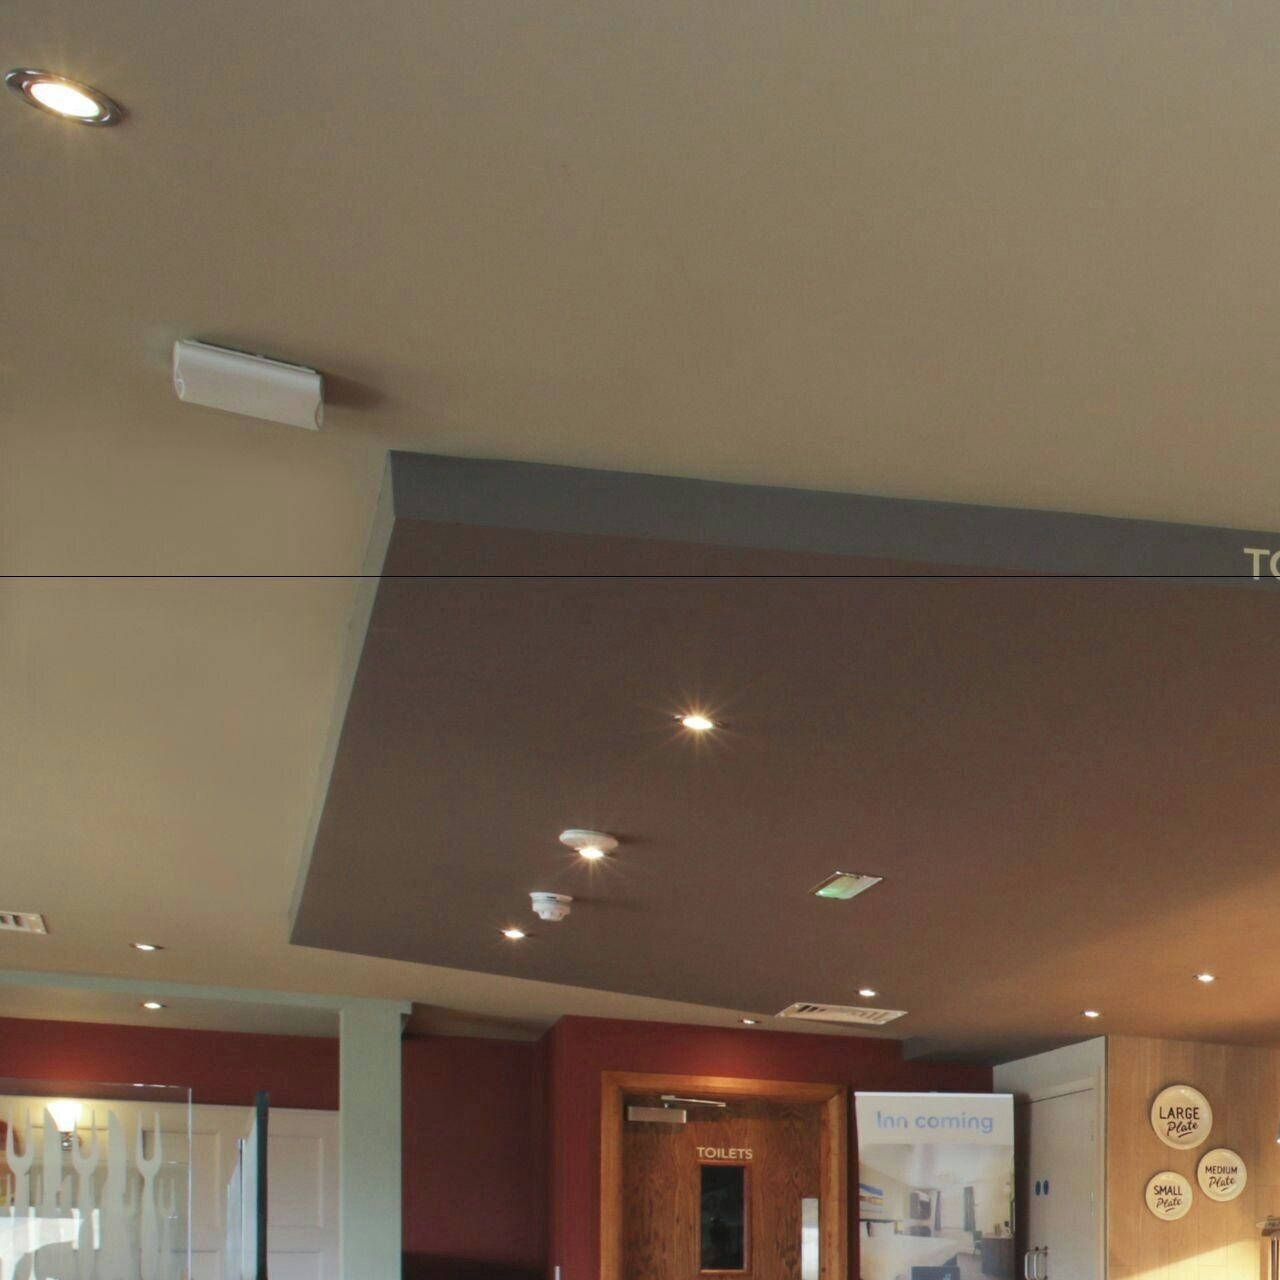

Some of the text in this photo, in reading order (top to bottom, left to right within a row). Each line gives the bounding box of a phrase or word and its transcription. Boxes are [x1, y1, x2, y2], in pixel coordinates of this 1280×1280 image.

[1159, 1106, 1200, 1120] LARGE
[877, 1111, 993, 1134] Inn coming
[1167, 1120, 1199, 1136] Plate
[696, 1146, 753, 1160] TOILETS
[1205, 1165, 1238, 1175] MEDIUM
[1208, 1176, 1236, 1188] Plate
[1154, 1185, 1182, 1196] SMALL
[1156, 1197, 1182, 1208] Plate
